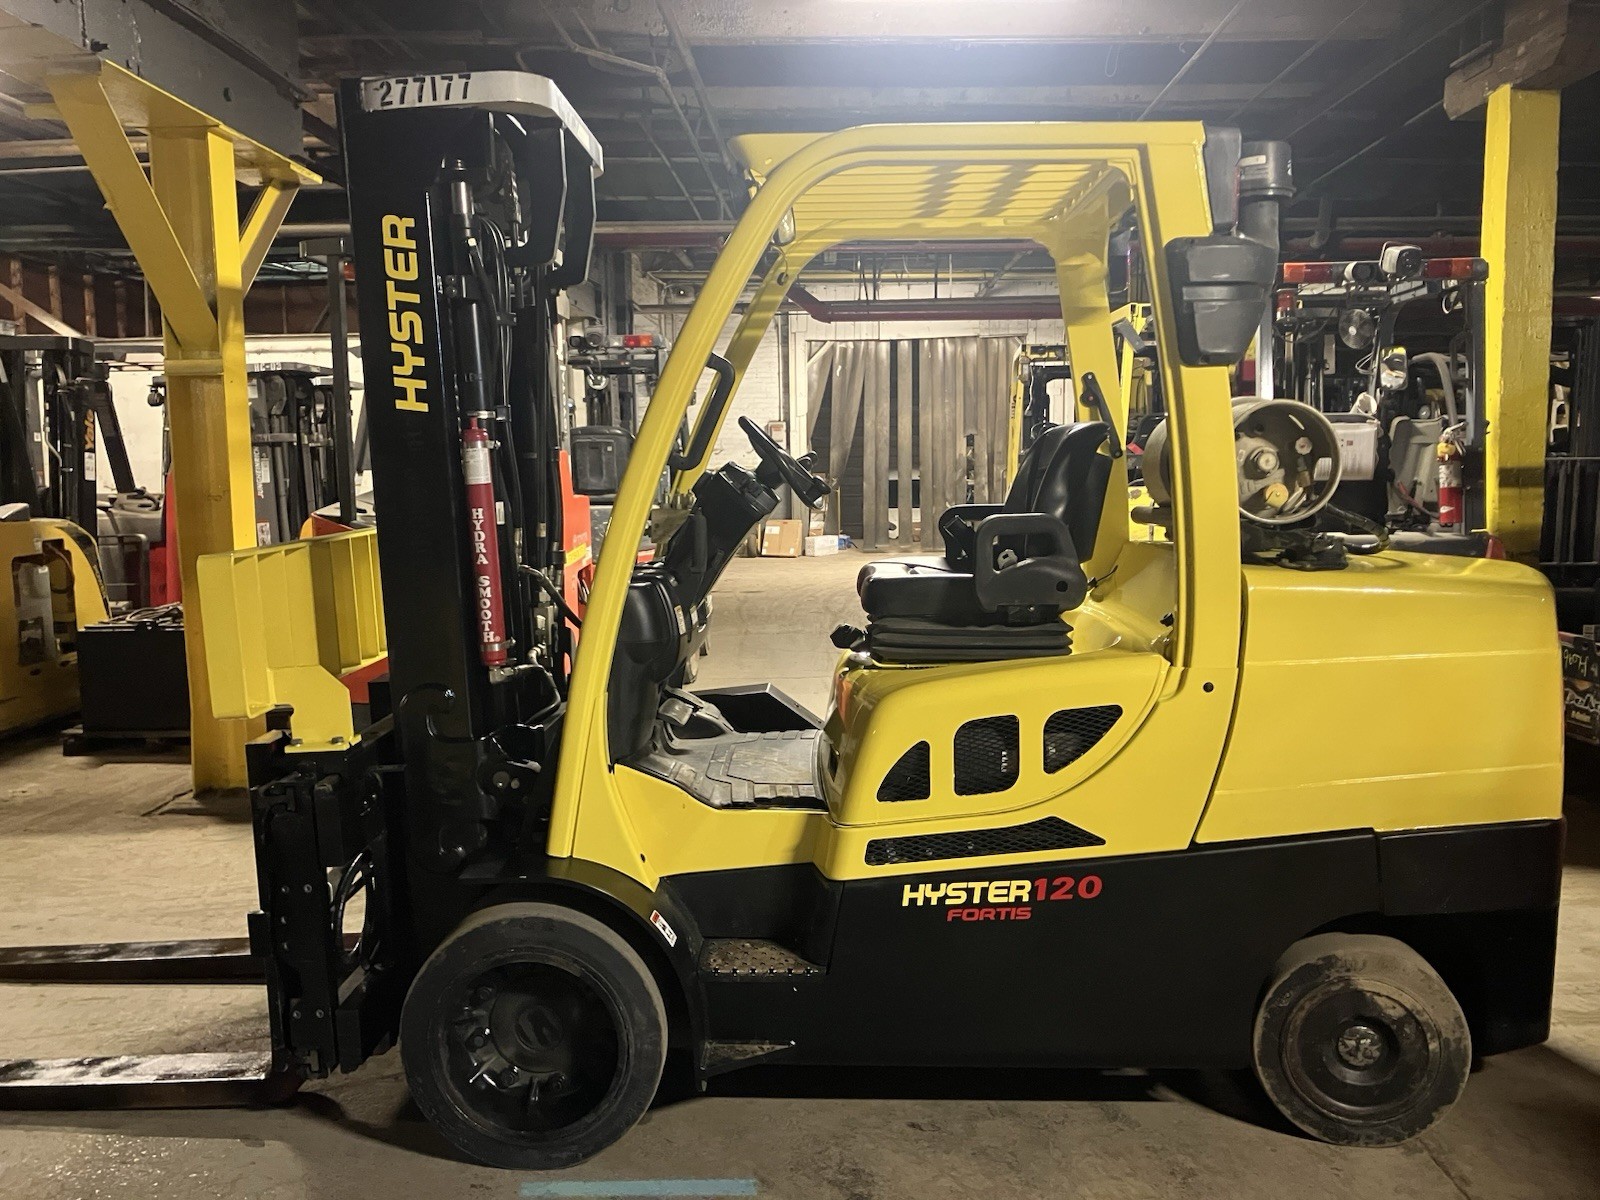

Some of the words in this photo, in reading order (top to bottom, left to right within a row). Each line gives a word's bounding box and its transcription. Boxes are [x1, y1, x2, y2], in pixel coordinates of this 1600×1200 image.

[382, 214, 429, 413] HYSTER
[84, 409, 95, 450] Yale
[471, 508, 489, 565] HYDRA
[478, 576, 496, 643] SMOOTH
[902, 879, 1032, 907] HYSTER
[1034, 875, 1103, 901] 120
[946, 907, 1032, 922] FORTIS
